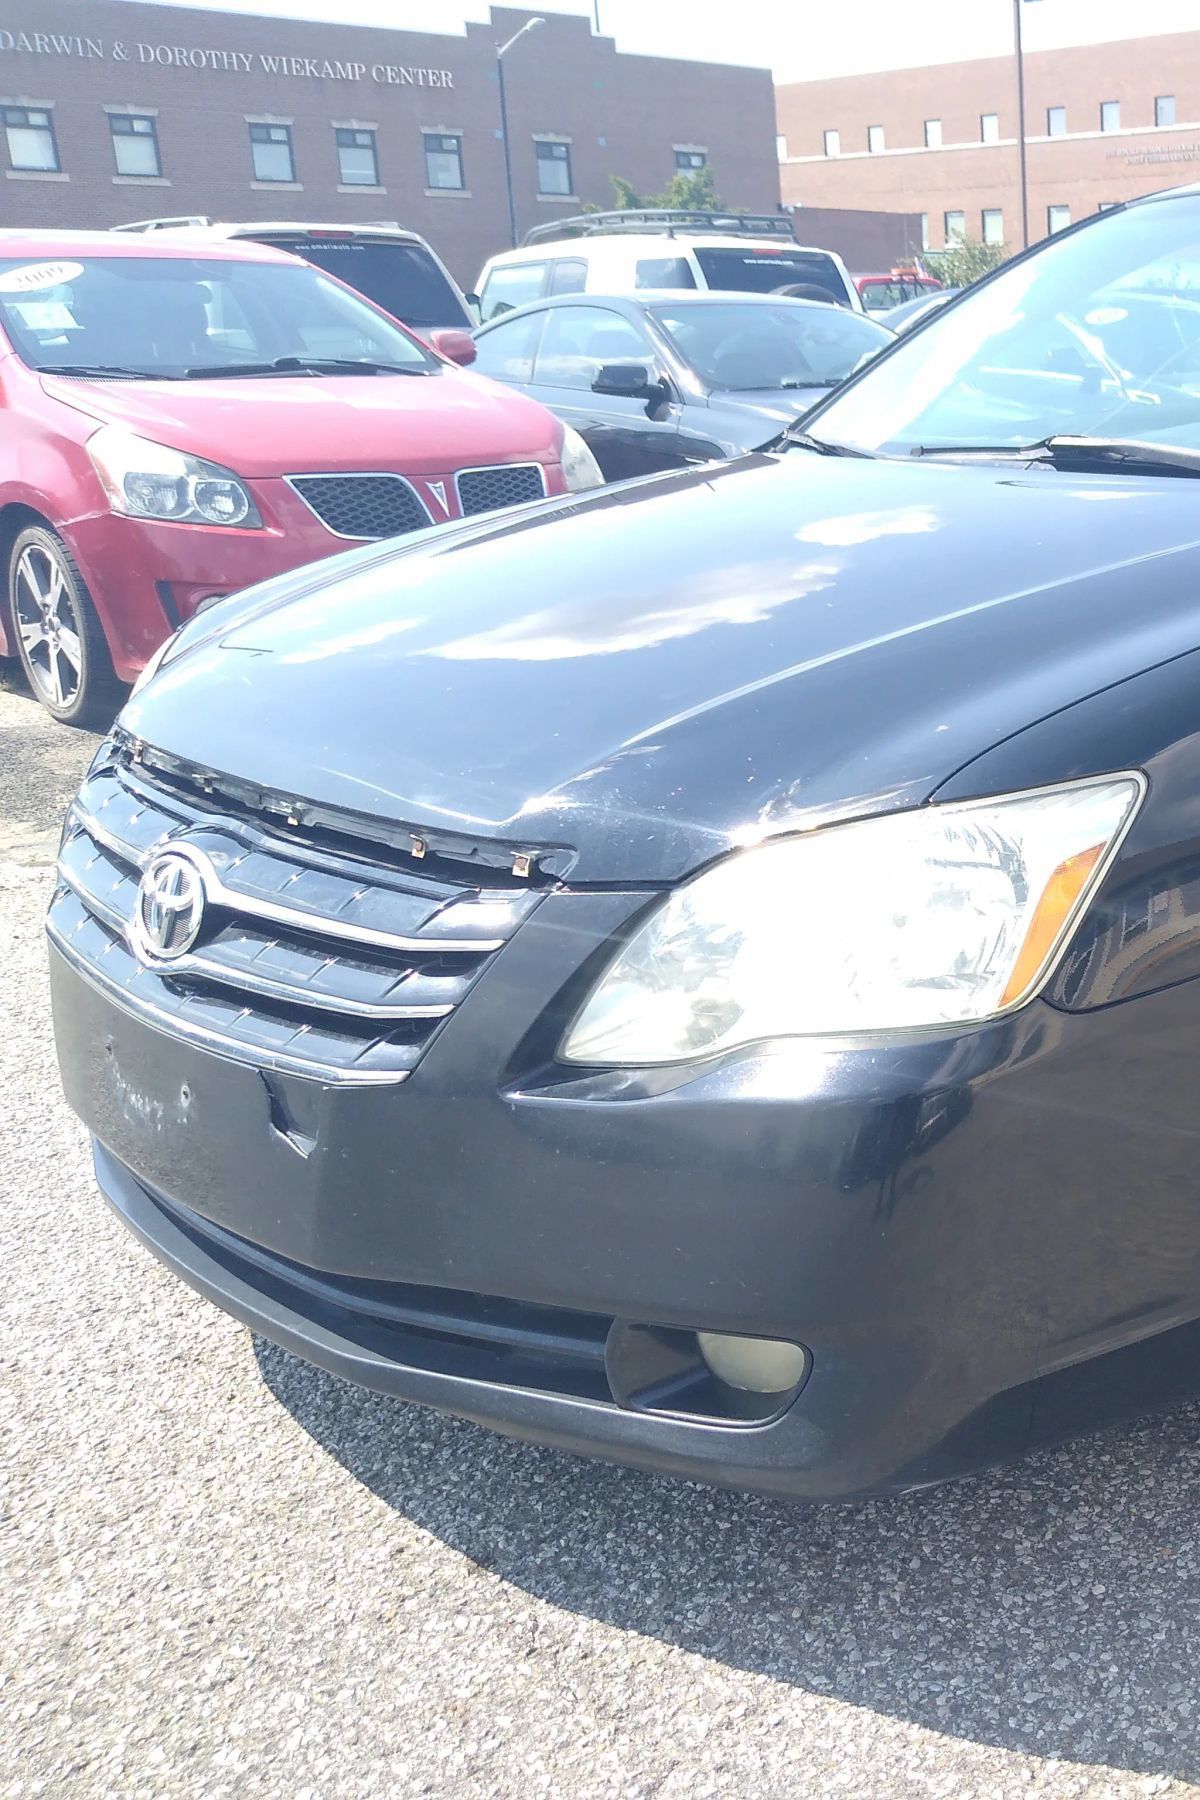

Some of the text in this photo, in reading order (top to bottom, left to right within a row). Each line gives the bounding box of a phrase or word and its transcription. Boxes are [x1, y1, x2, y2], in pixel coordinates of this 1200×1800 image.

[0, 30, 454, 88] DARWIN & DOROTHY WIEKAMP CENTER
